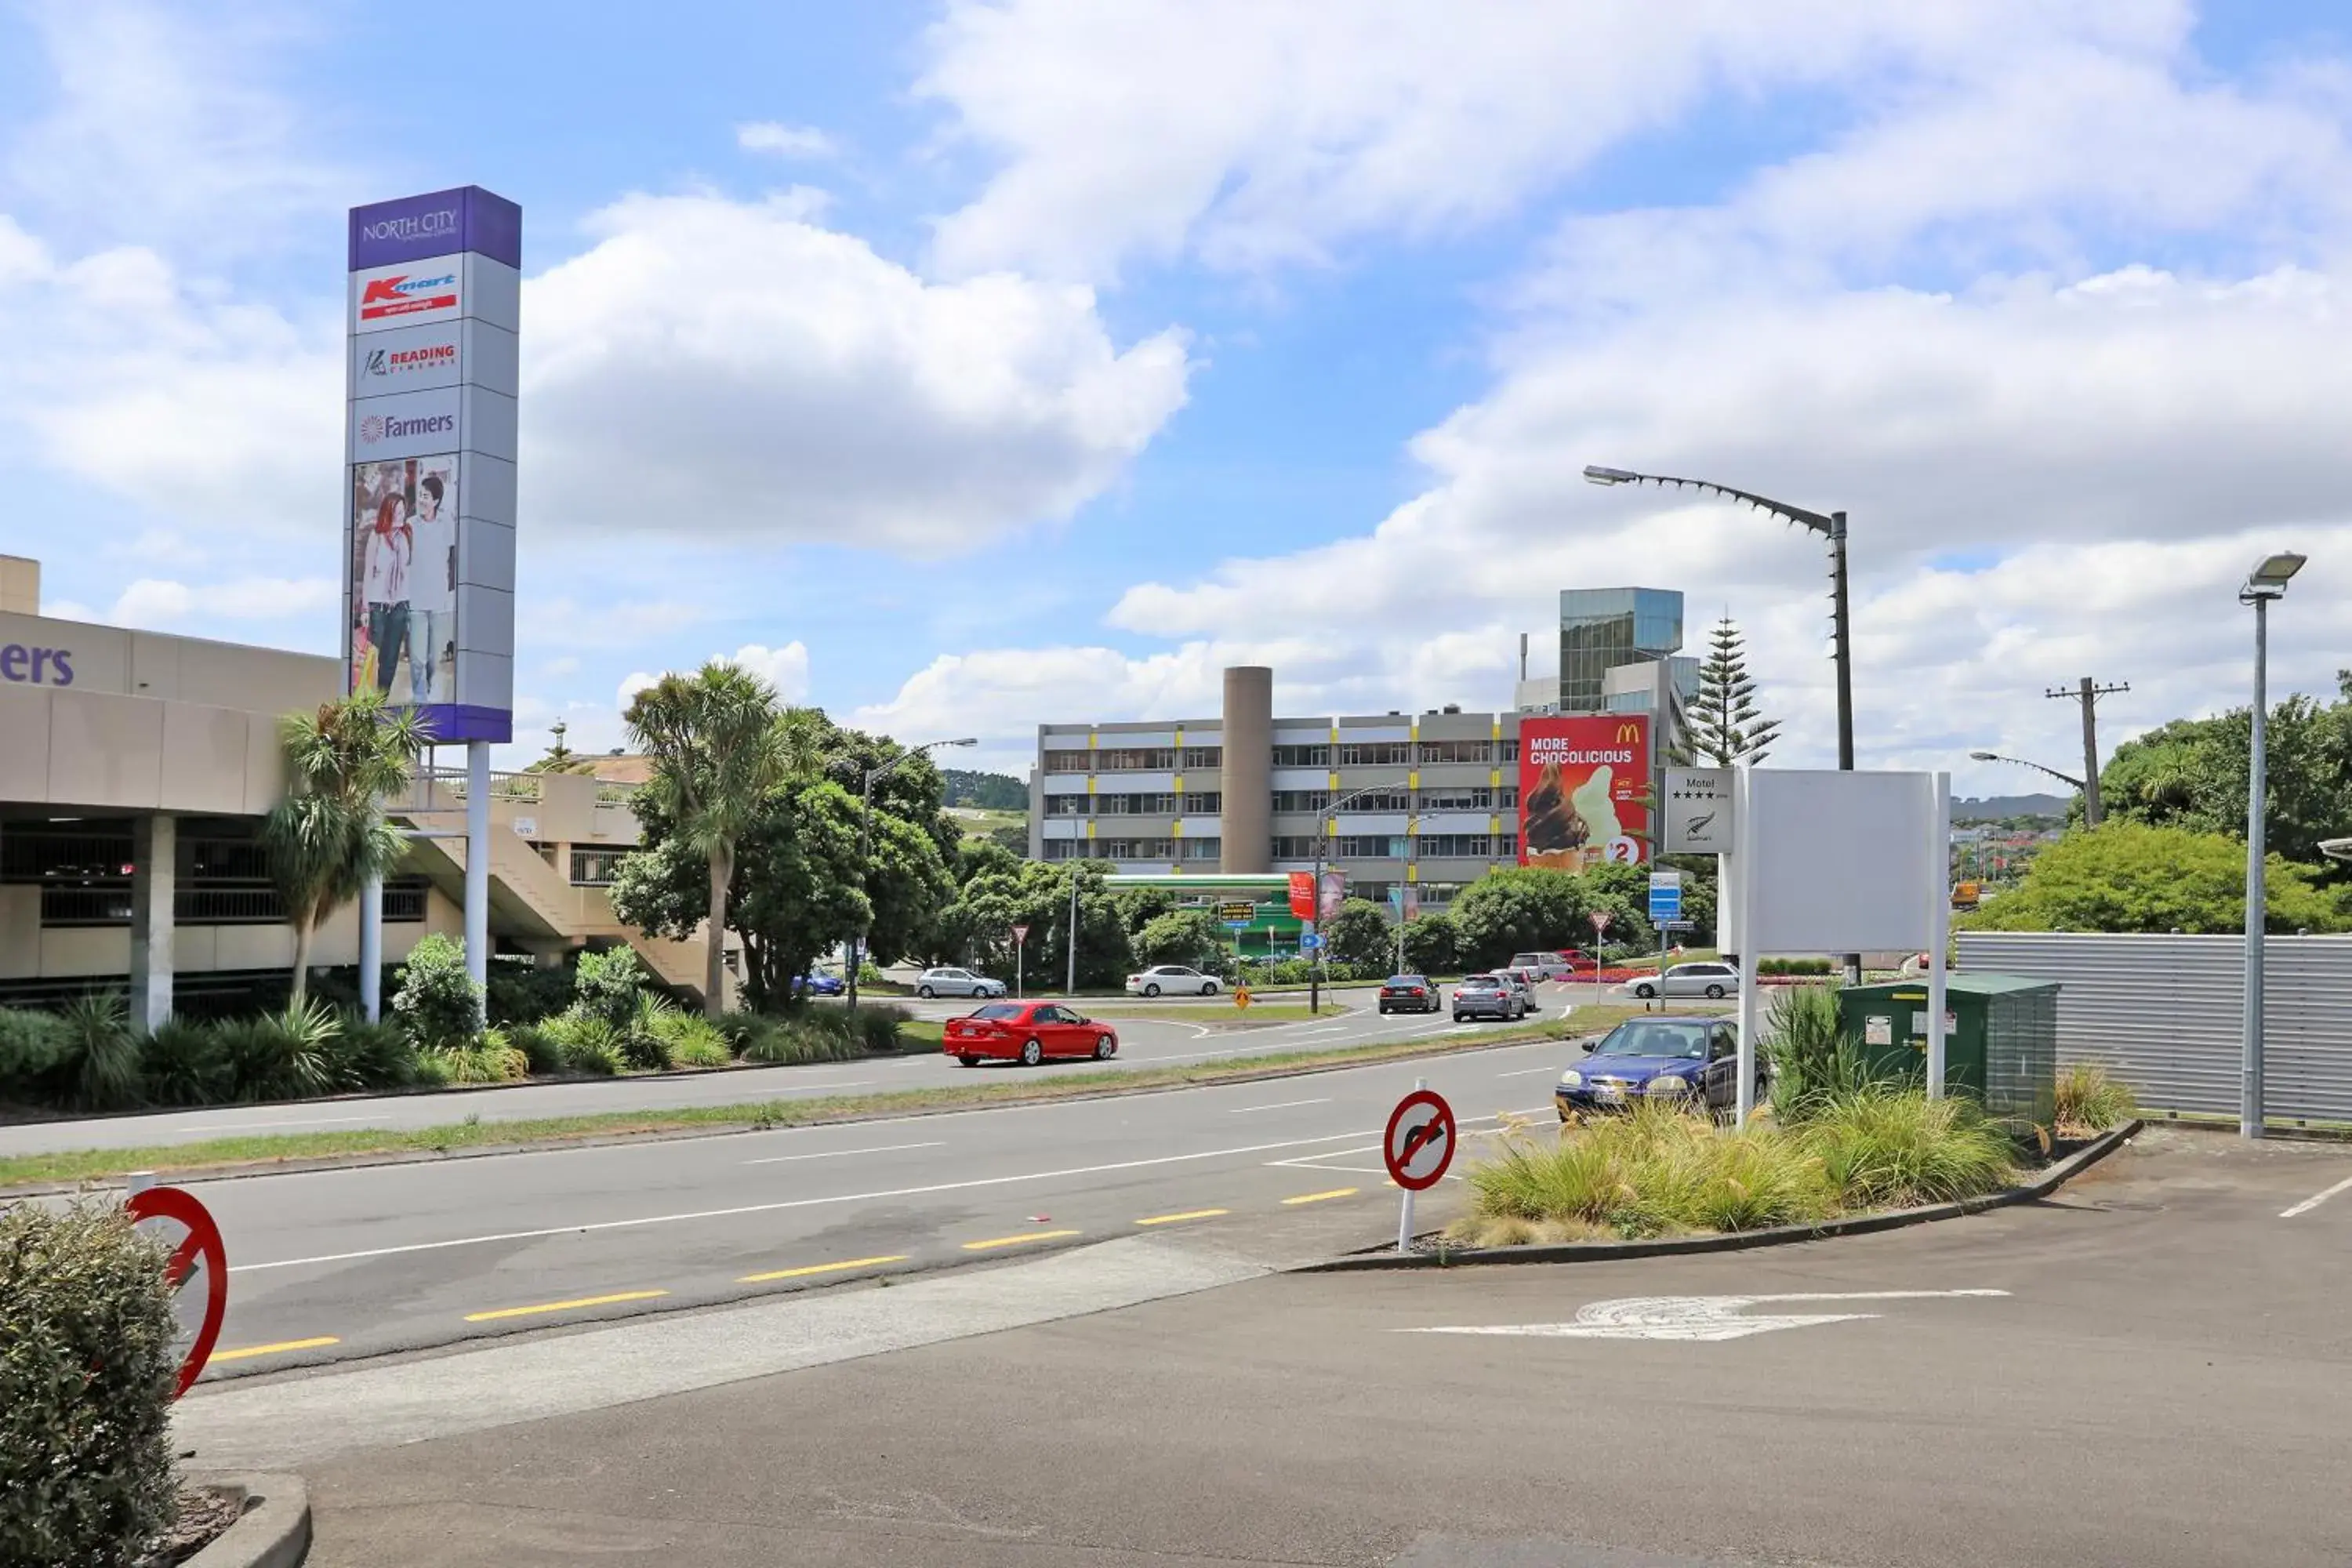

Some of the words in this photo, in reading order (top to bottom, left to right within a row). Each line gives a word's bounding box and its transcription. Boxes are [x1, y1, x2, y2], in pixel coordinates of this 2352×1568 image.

[363, 216, 419, 242] NORTH
[422, 209, 457, 232] CITY
[363, 274, 456, 305] Kmart
[390, 345, 454, 365] READING
[385, 415, 453, 438] Farmers
[0, 643, 74, 687] ers
[1530, 738, 1569, 751] MORE
[1530, 750, 1632, 764] CHOCOLICIOUS
[1686, 778, 1715, 789] Motel
